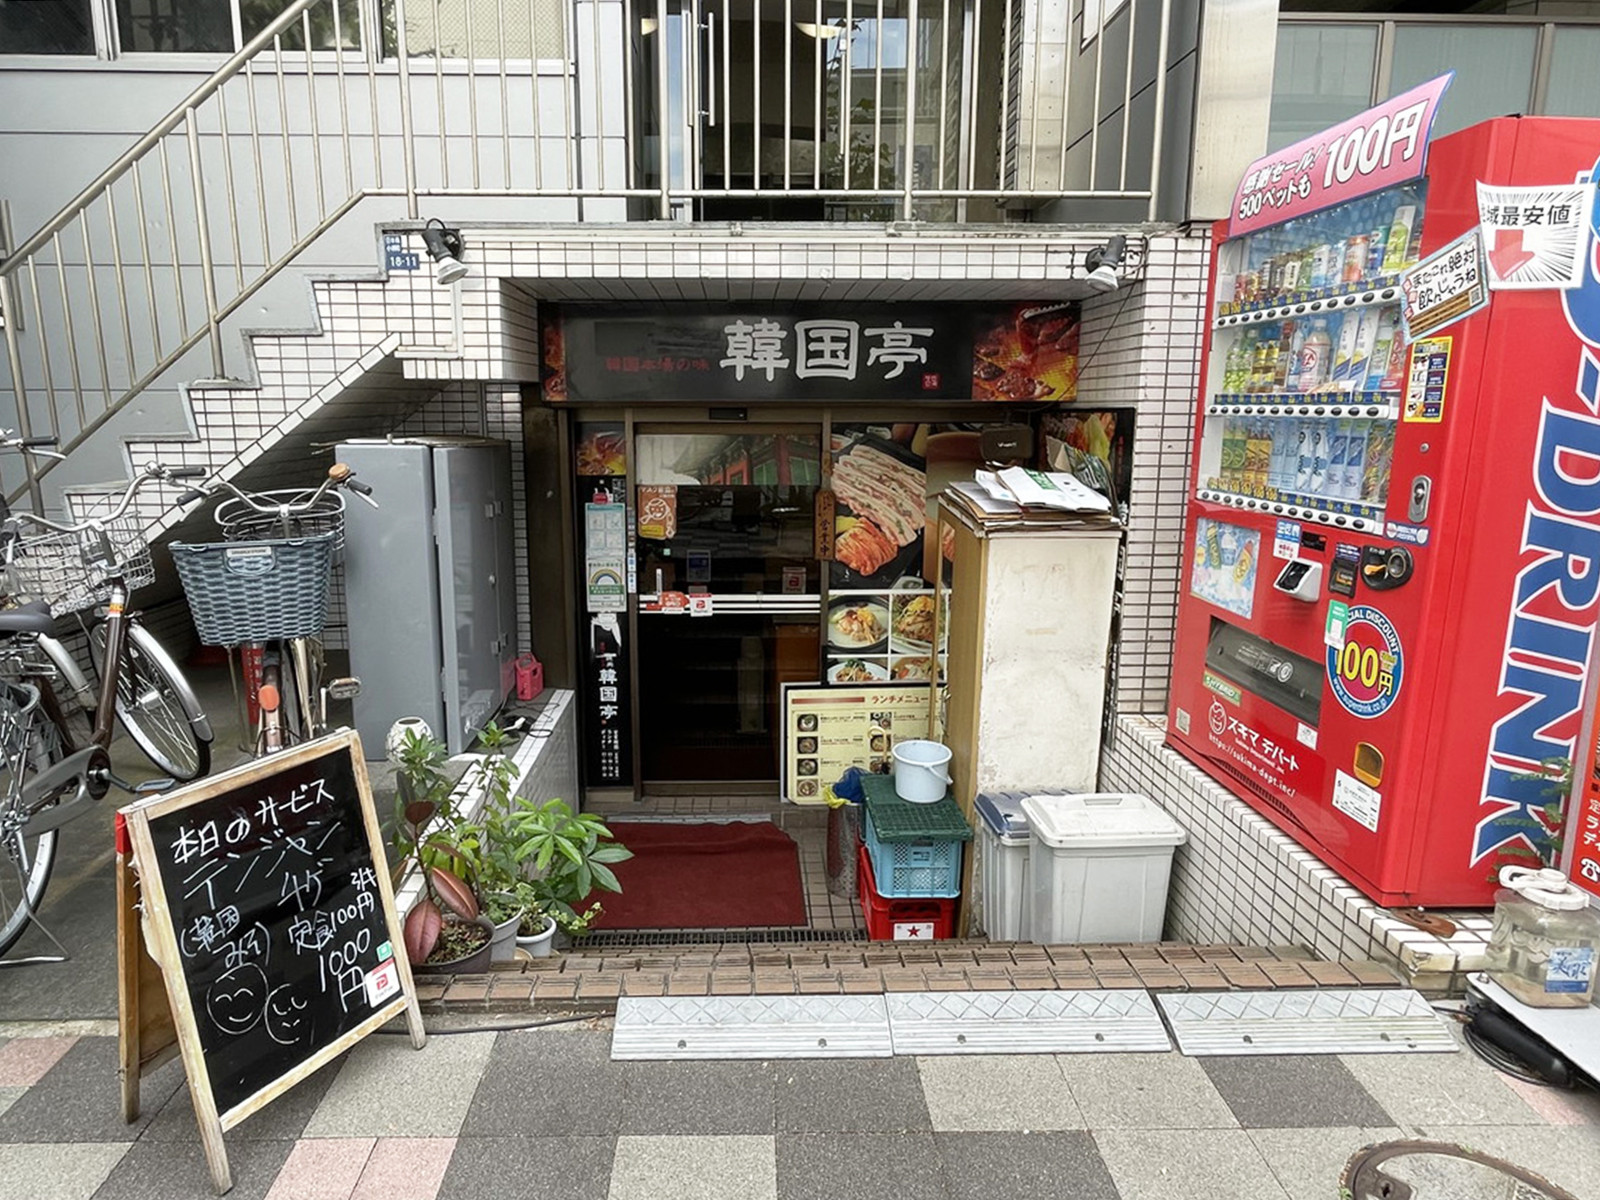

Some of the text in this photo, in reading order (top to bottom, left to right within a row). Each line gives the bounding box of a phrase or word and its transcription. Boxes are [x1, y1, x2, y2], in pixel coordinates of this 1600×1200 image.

[1323, 98, 1430, 190] 100円
[1239, 174, 1312, 220] 500ペットも
[719, 317, 934, 382] 韓国亭
[1365, 609, 1400, 656] DISCOUNT
[871, 695, 929, 704] ランチメニュー
[1262, 738, 1300, 771] デパート
[170, 778, 335, 864] 本日のサービス
[338, 965, 368, 1013] 円
